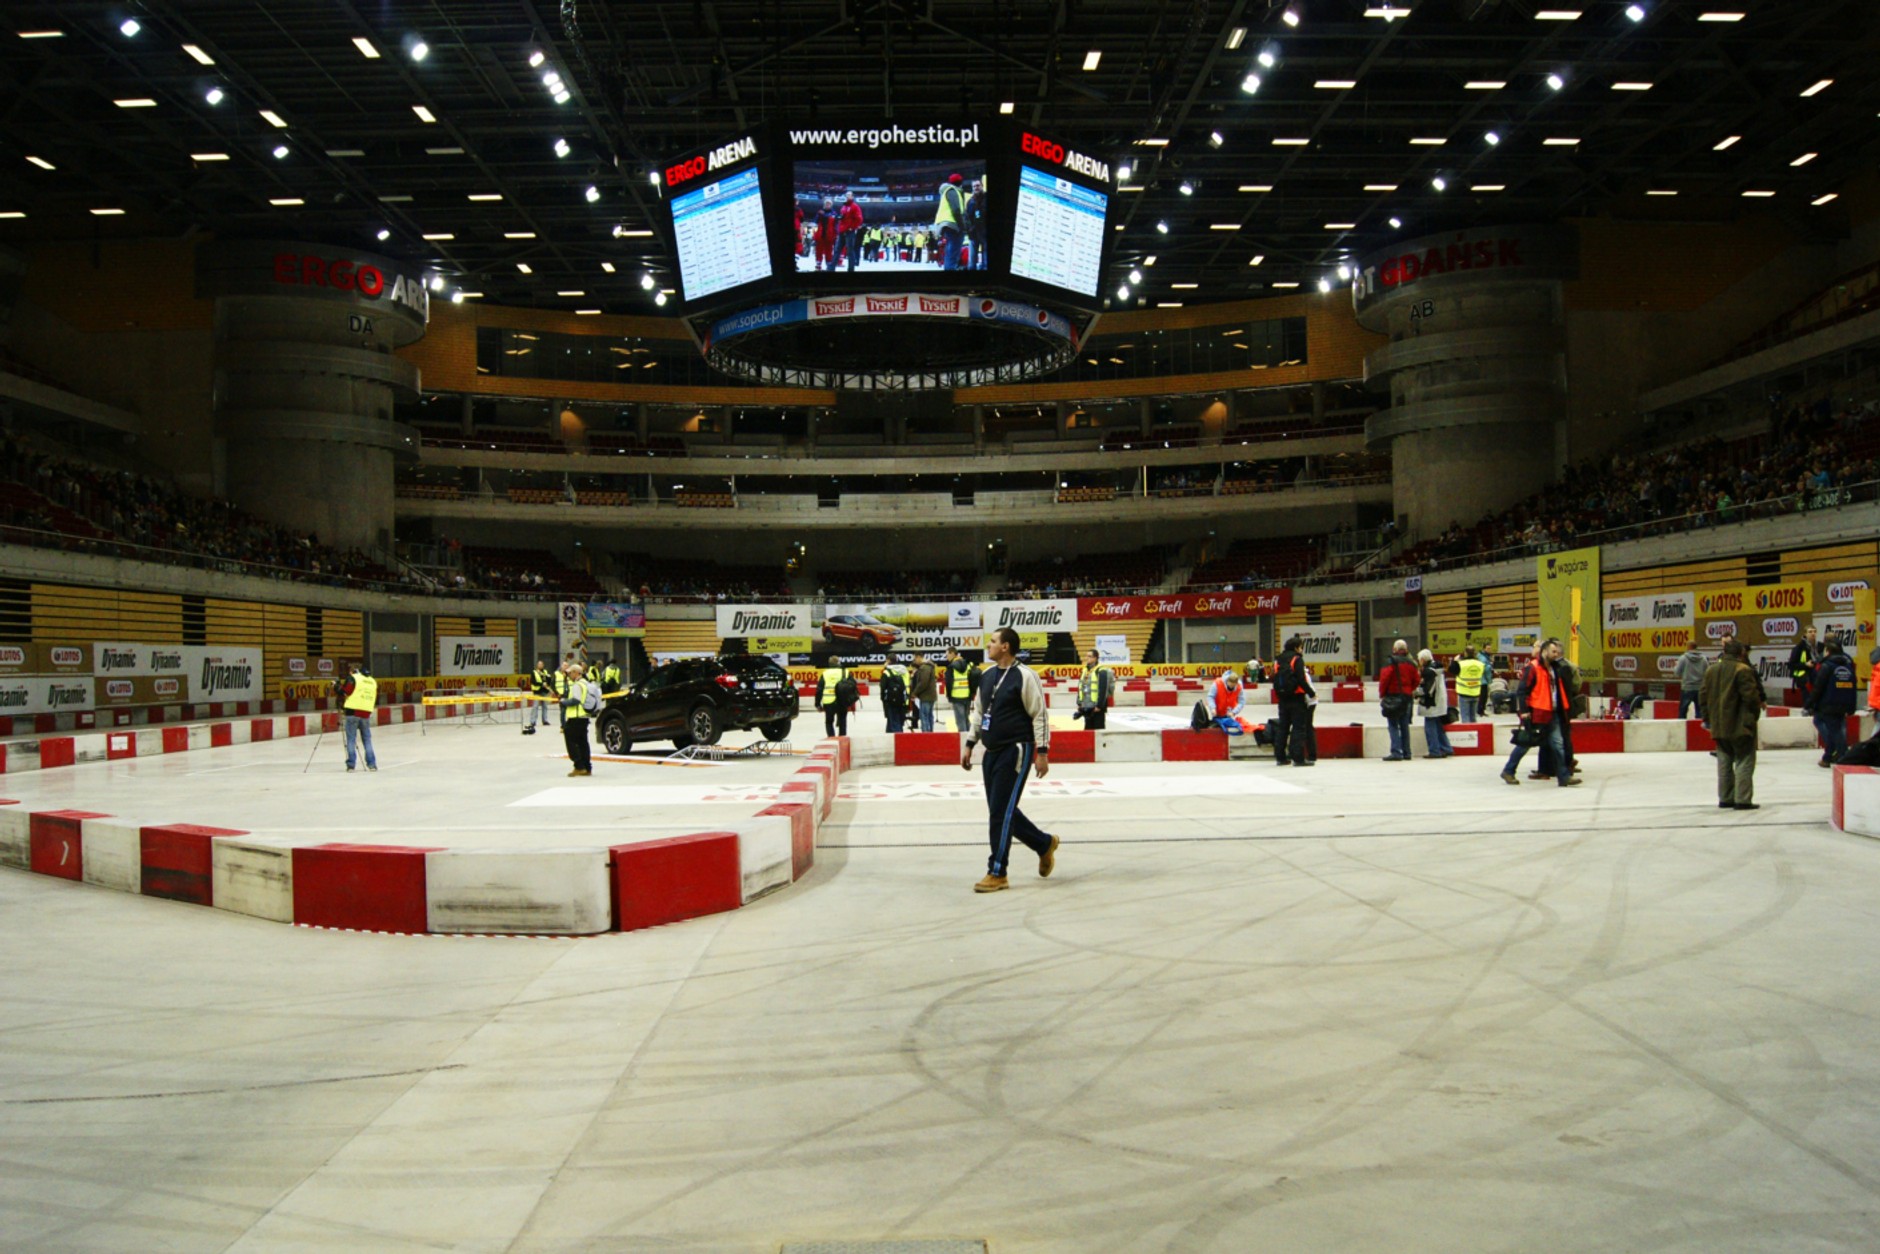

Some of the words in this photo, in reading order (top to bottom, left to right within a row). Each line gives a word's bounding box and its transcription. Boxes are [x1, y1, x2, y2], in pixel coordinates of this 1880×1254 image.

[790, 124, 980, 148] www.ergohestia.pl
[665, 156, 707, 187] ERGO
[708, 136, 757, 172] ARENA
[1021, 132, 1064, 164] ERGO
[1065, 150, 1110, 183] ARENA
[1380, 232, 1524, 287] GDAŃSK
[273, 253, 385, 297] ERGO
[817, 300, 853, 315] TYSKIE
[869, 299, 905, 312] TYSKIE
[923, 300, 957, 312] TYSKIE
[1000, 304, 1032, 320] pepsi
[1410, 301, 1434, 322] AB
[350, 315, 374, 335] DA
[718, 305, 783, 335] www.sopot.pl
[1557, 560, 1589, 576] wzgórze
[1209, 598, 1232, 612] Trefl
[1257, 595, 1280, 609] Trefl
[1711, 592, 1743, 612] LOTOS
[1769, 588, 1805, 608] LOTOS
[1105, 602, 1131, 616] Trefl
[1158, 600, 1183, 614] Trefl
[1608, 604, 1639, 625] Dynamic
[1652, 600, 1687, 622] Dynamic
[732, 611, 797, 633] Dynamic
[999, 607, 1063, 628] Dynamic
[905, 623, 945, 635] Nowy
[1772, 620, 1795, 633] LOTOS
[769, 637, 804, 649] wzgórze
[905, 636, 961, 648] SUBARU
[962, 636, 982, 646] XV
[1617, 632, 1642, 648] LOTOS
[1661, 630, 1689, 648] LOTOS
[60, 650, 80, 661] LOTOS
[101, 648, 137, 672] Dynamic
[151, 651, 182, 672] Dynamic
[453, 644, 503, 670] Dynamic
[1620, 657, 1636, 669] LOTOS
[201, 657, 252, 696] Dynamic
[1158, 665, 1185, 676] LOTOS
[1206, 665, 1233, 675] LOTOS
[1334, 665, 1357, 676] LOTOS
[115, 683, 132, 694] LOTOS
[162, 680, 178, 692] LOTOS
[442, 678, 466, 689] LOTOS
[485, 677, 508, 688] LOTOS
[48, 684, 87, 709] Dynamic
[295, 684, 320, 699] LOTOS
